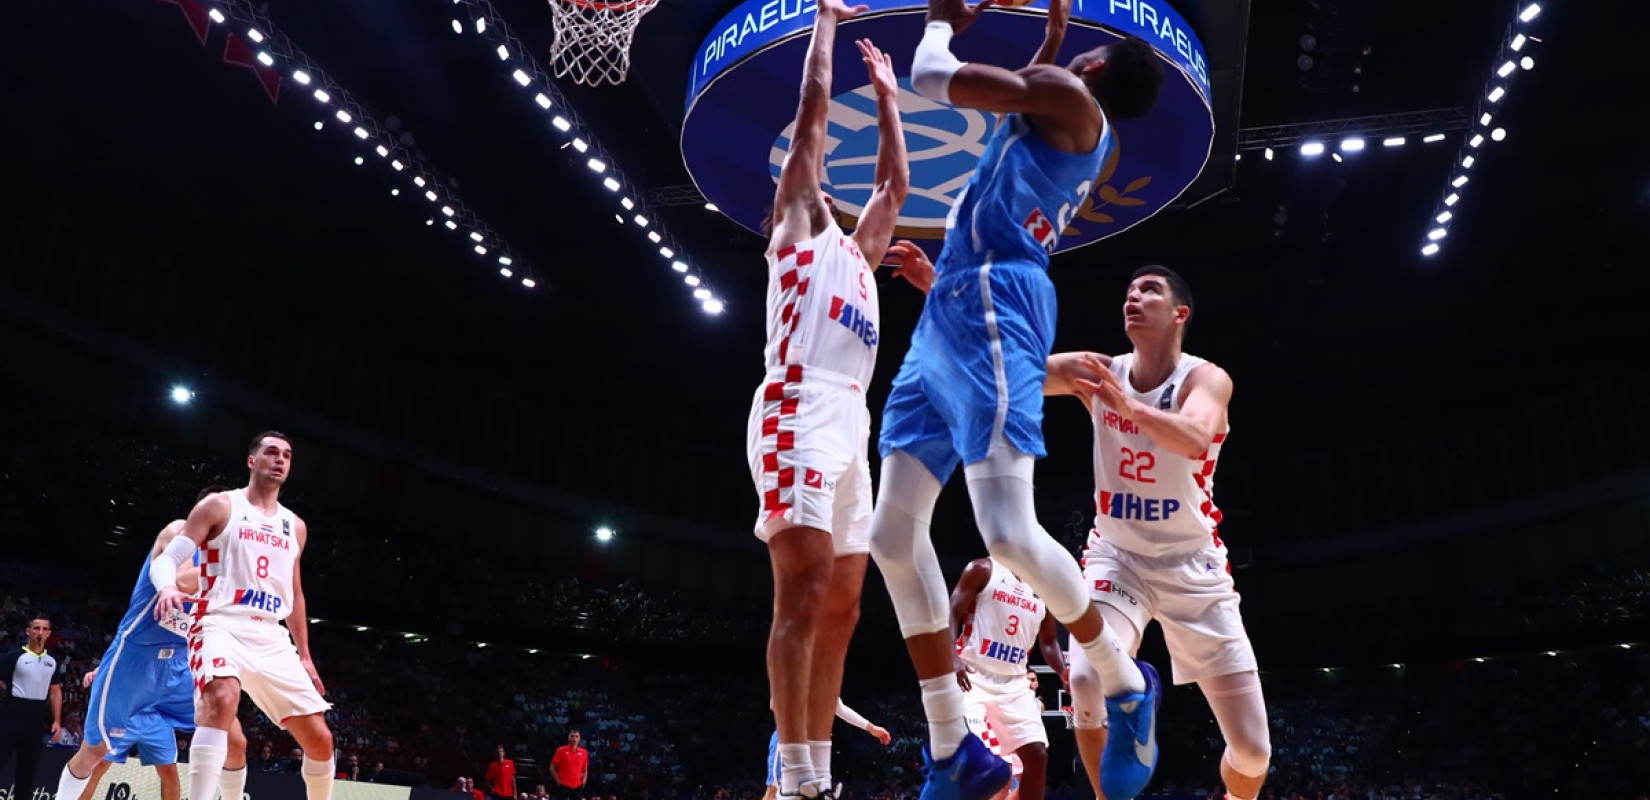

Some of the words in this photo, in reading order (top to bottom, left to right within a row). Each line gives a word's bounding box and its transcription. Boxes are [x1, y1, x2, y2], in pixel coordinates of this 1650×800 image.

[1103, 410, 1139, 435] HRVA
[1119, 446, 1156, 484] 22
[1125, 493, 1180, 521] HEP
[239, 528, 290, 551] HRVATSKA
[256, 555, 268, 579] 8
[251, 590, 282, 613] HEP
[992, 589, 1038, 614] HRVATSKA
[1005, 615, 1019, 636] 3
[996, 642, 1026, 665] HEP
